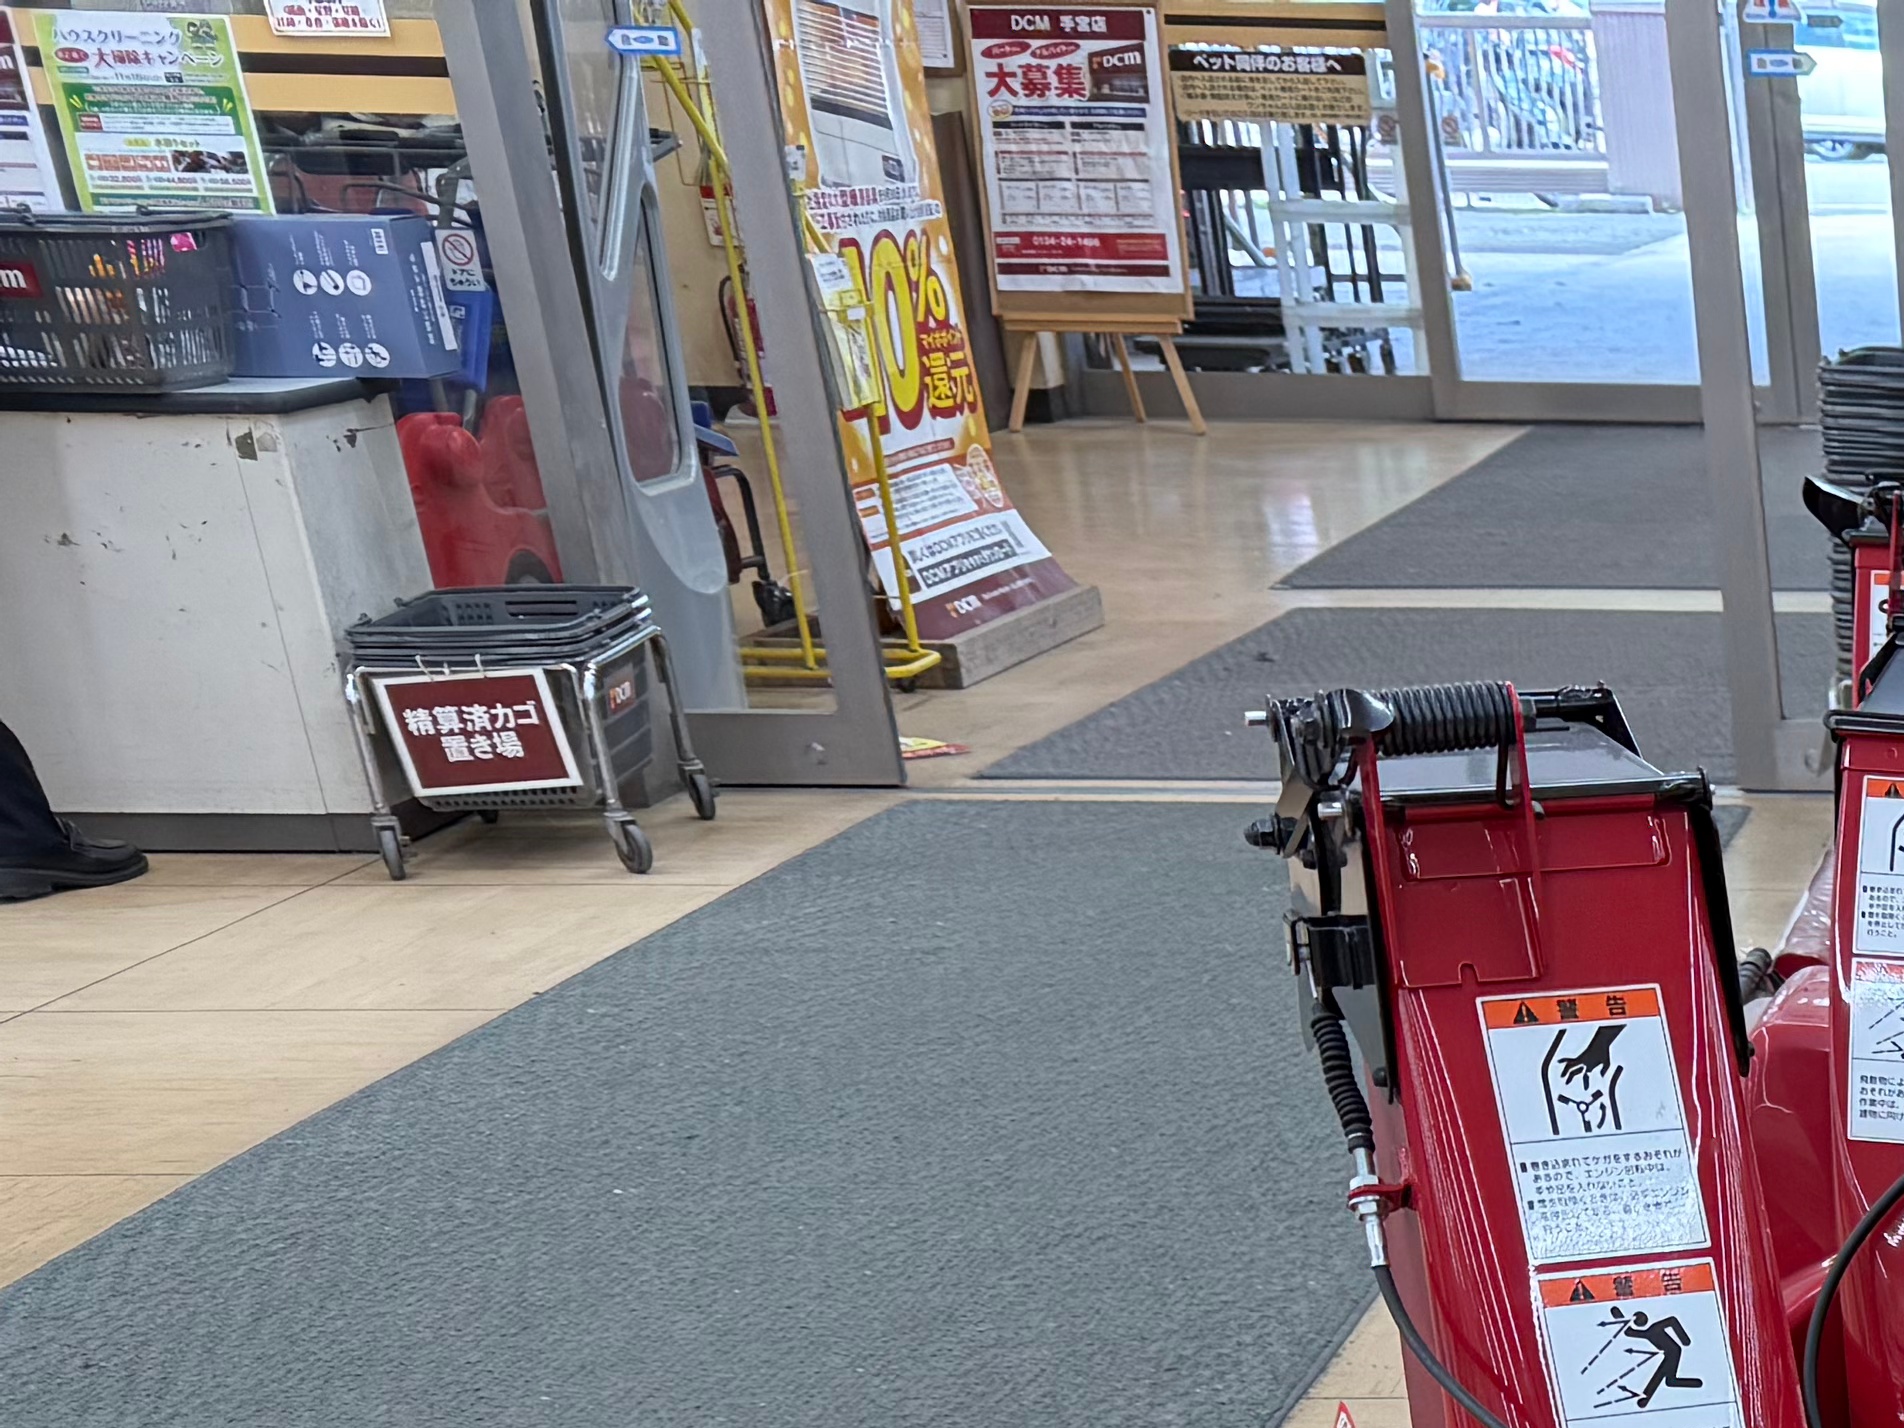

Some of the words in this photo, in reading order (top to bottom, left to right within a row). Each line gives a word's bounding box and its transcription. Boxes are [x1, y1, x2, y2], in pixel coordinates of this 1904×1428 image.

[53, 29, 181, 46] ハウスクリーニング
[93, 48, 224, 69] 大掃除キャンペーン
[985, 63, 1088, 100] 大募集
[921, 351, 976, 409] 還元
[403, 701, 539, 736] 精算済カゴ
[441, 732, 525, 763] 置き場
[1557, 995, 1627, 1020] 警告
